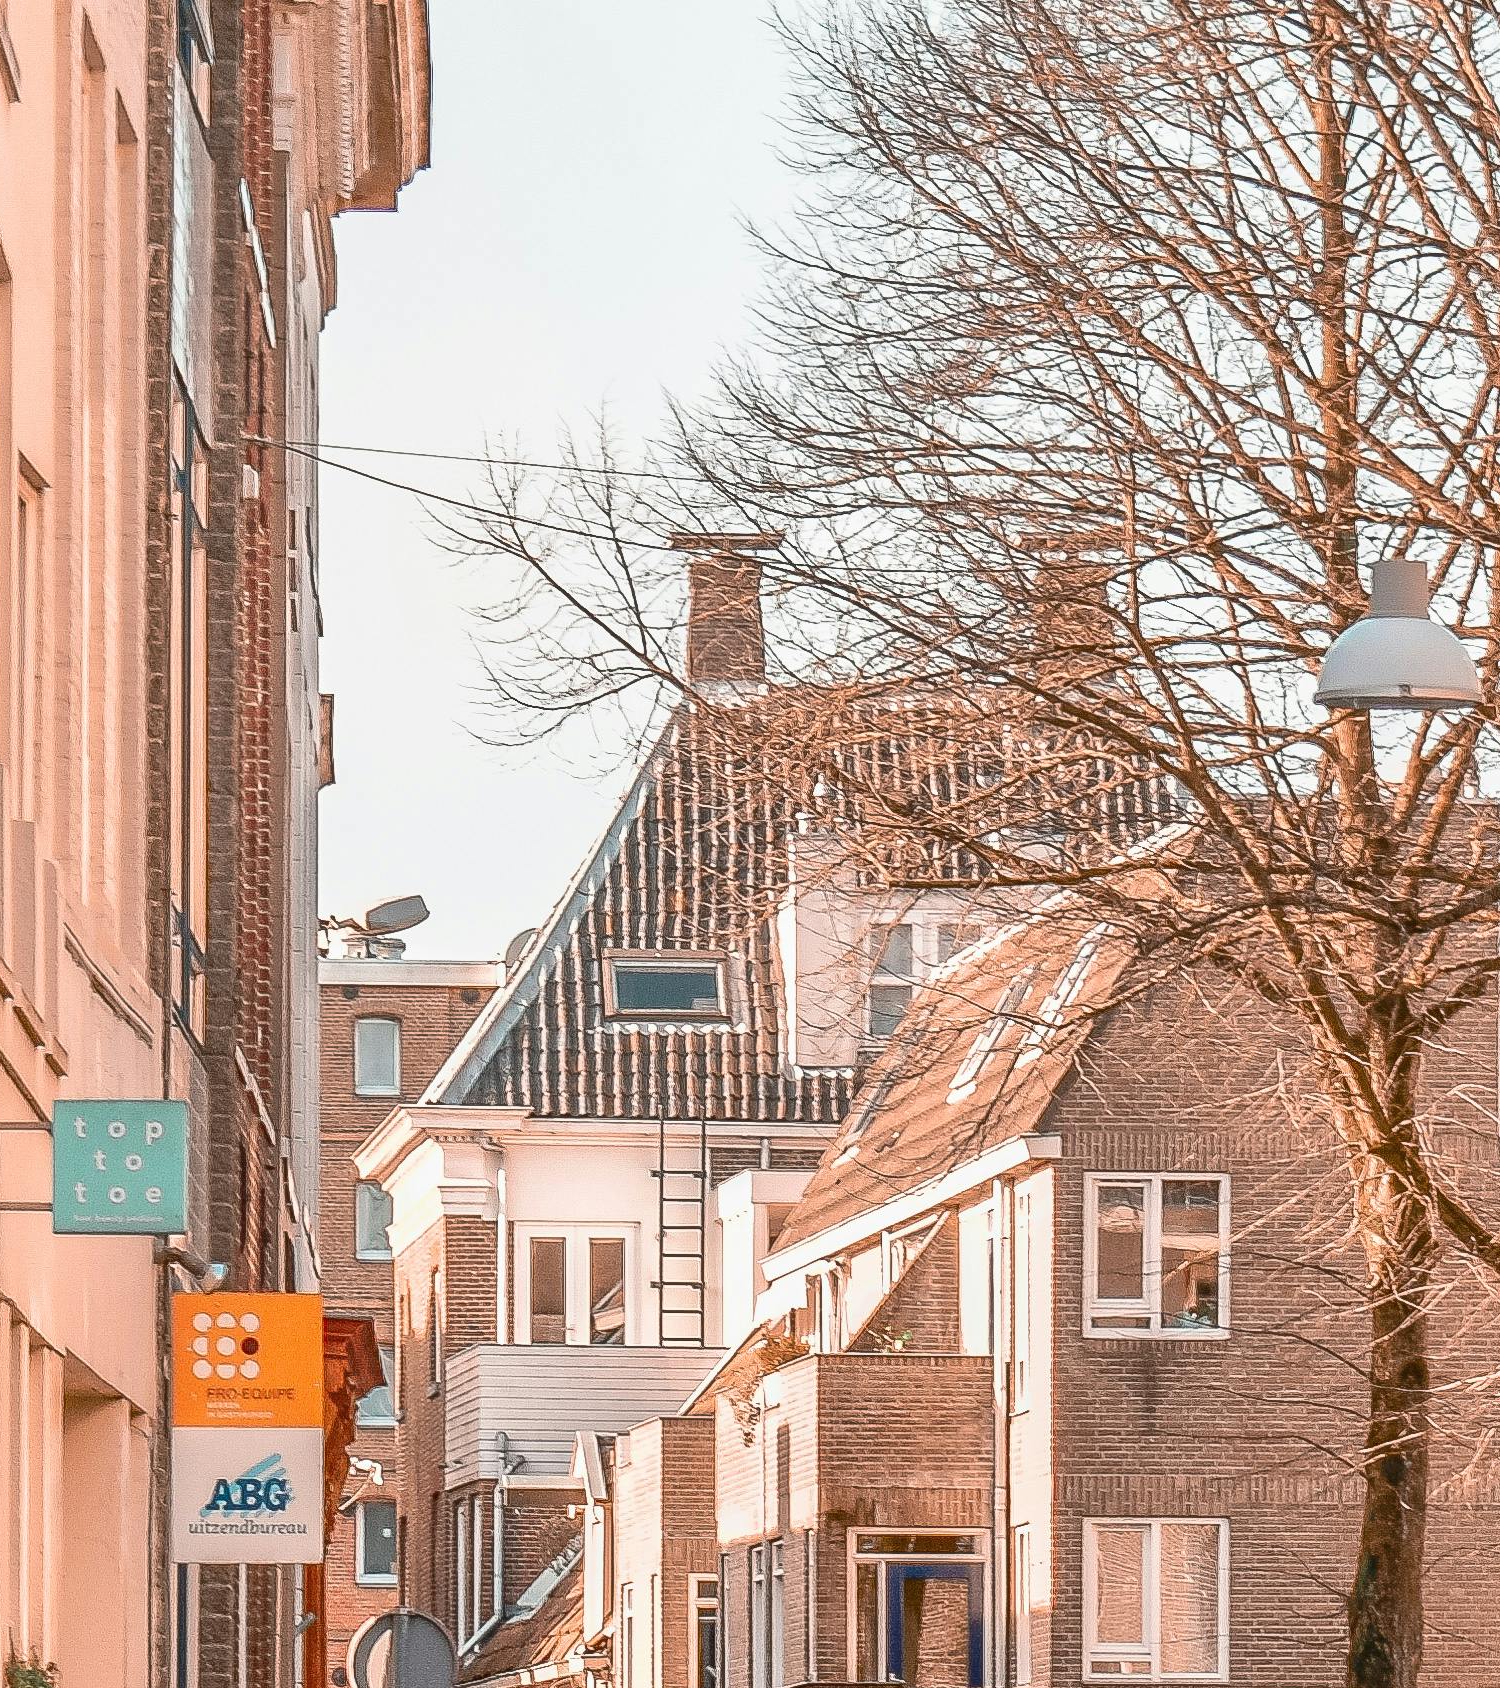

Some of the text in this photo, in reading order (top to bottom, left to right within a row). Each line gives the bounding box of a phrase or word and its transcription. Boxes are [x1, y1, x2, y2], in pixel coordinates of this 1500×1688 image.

[74, 1116, 164, 1145] top
[94, 1149, 143, 1171] to
[74, 1182, 162, 1203] toe
[204, 1477, 288, 1511] ABG
[188, 1518, 308, 1535] uitzendbureau
